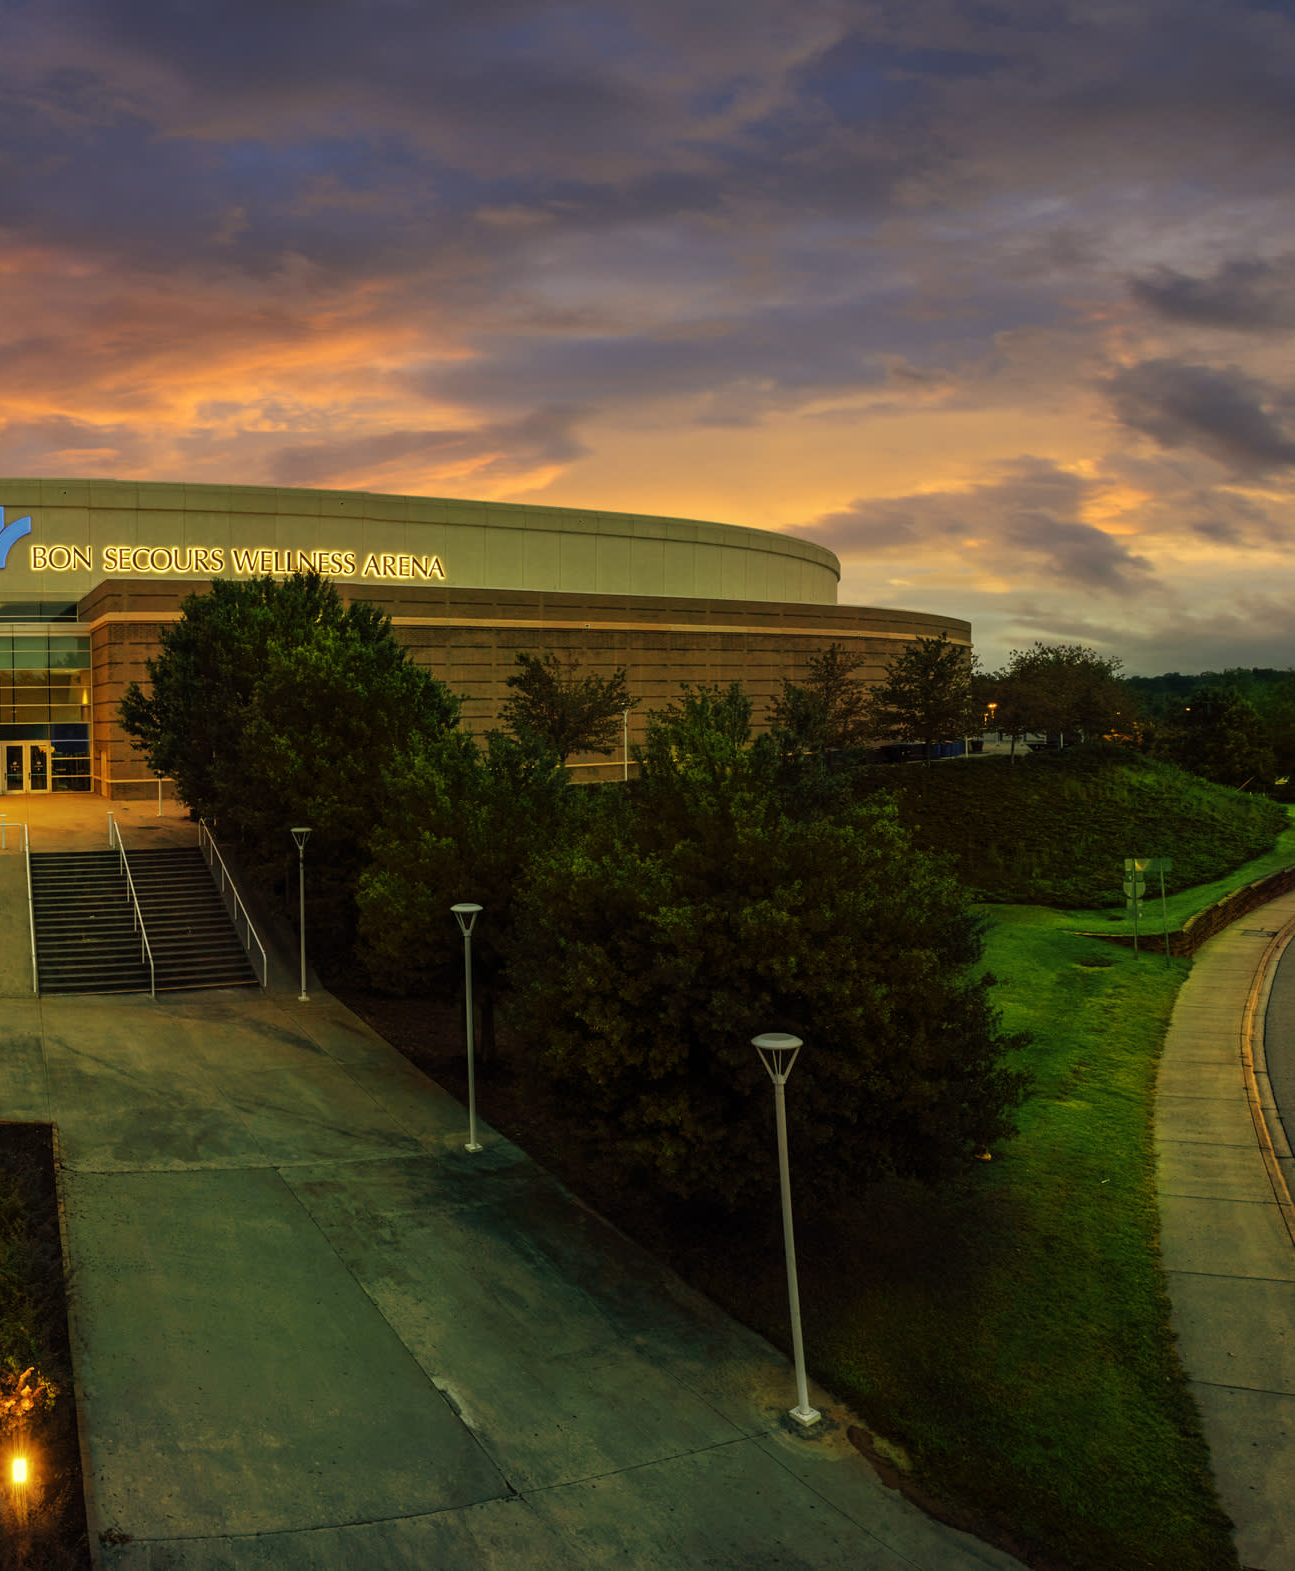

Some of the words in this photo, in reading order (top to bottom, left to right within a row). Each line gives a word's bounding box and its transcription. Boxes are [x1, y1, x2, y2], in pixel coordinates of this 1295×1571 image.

[31, 546, 92, 570] BON
[103, 547, 225, 572] SECOURS
[232, 549, 356, 575] WELLNESS
[362, 553, 445, 578] ARENA
